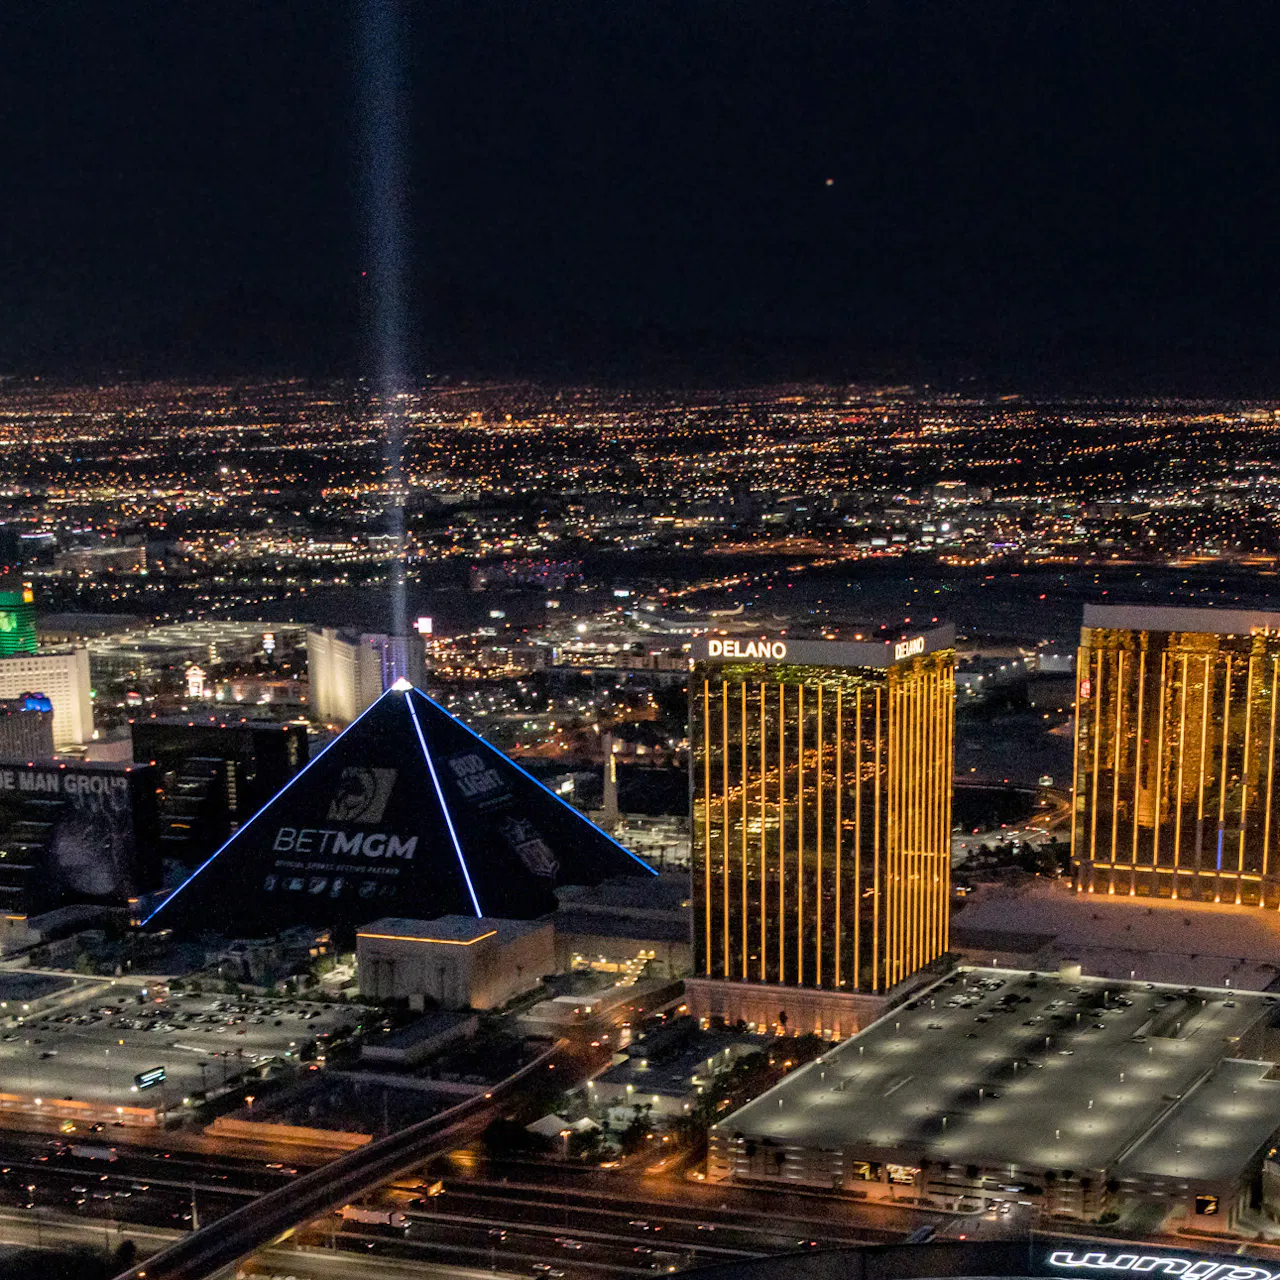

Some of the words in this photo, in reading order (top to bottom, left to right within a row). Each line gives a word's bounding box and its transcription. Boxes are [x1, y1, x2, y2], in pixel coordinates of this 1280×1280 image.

[708, 639, 787, 660] DELANO
[894, 636, 925, 661] DELANO
[19, 772, 59, 793] MAN
[64, 774, 128, 795] GROUP
[273, 827, 419, 860] BETMGM
